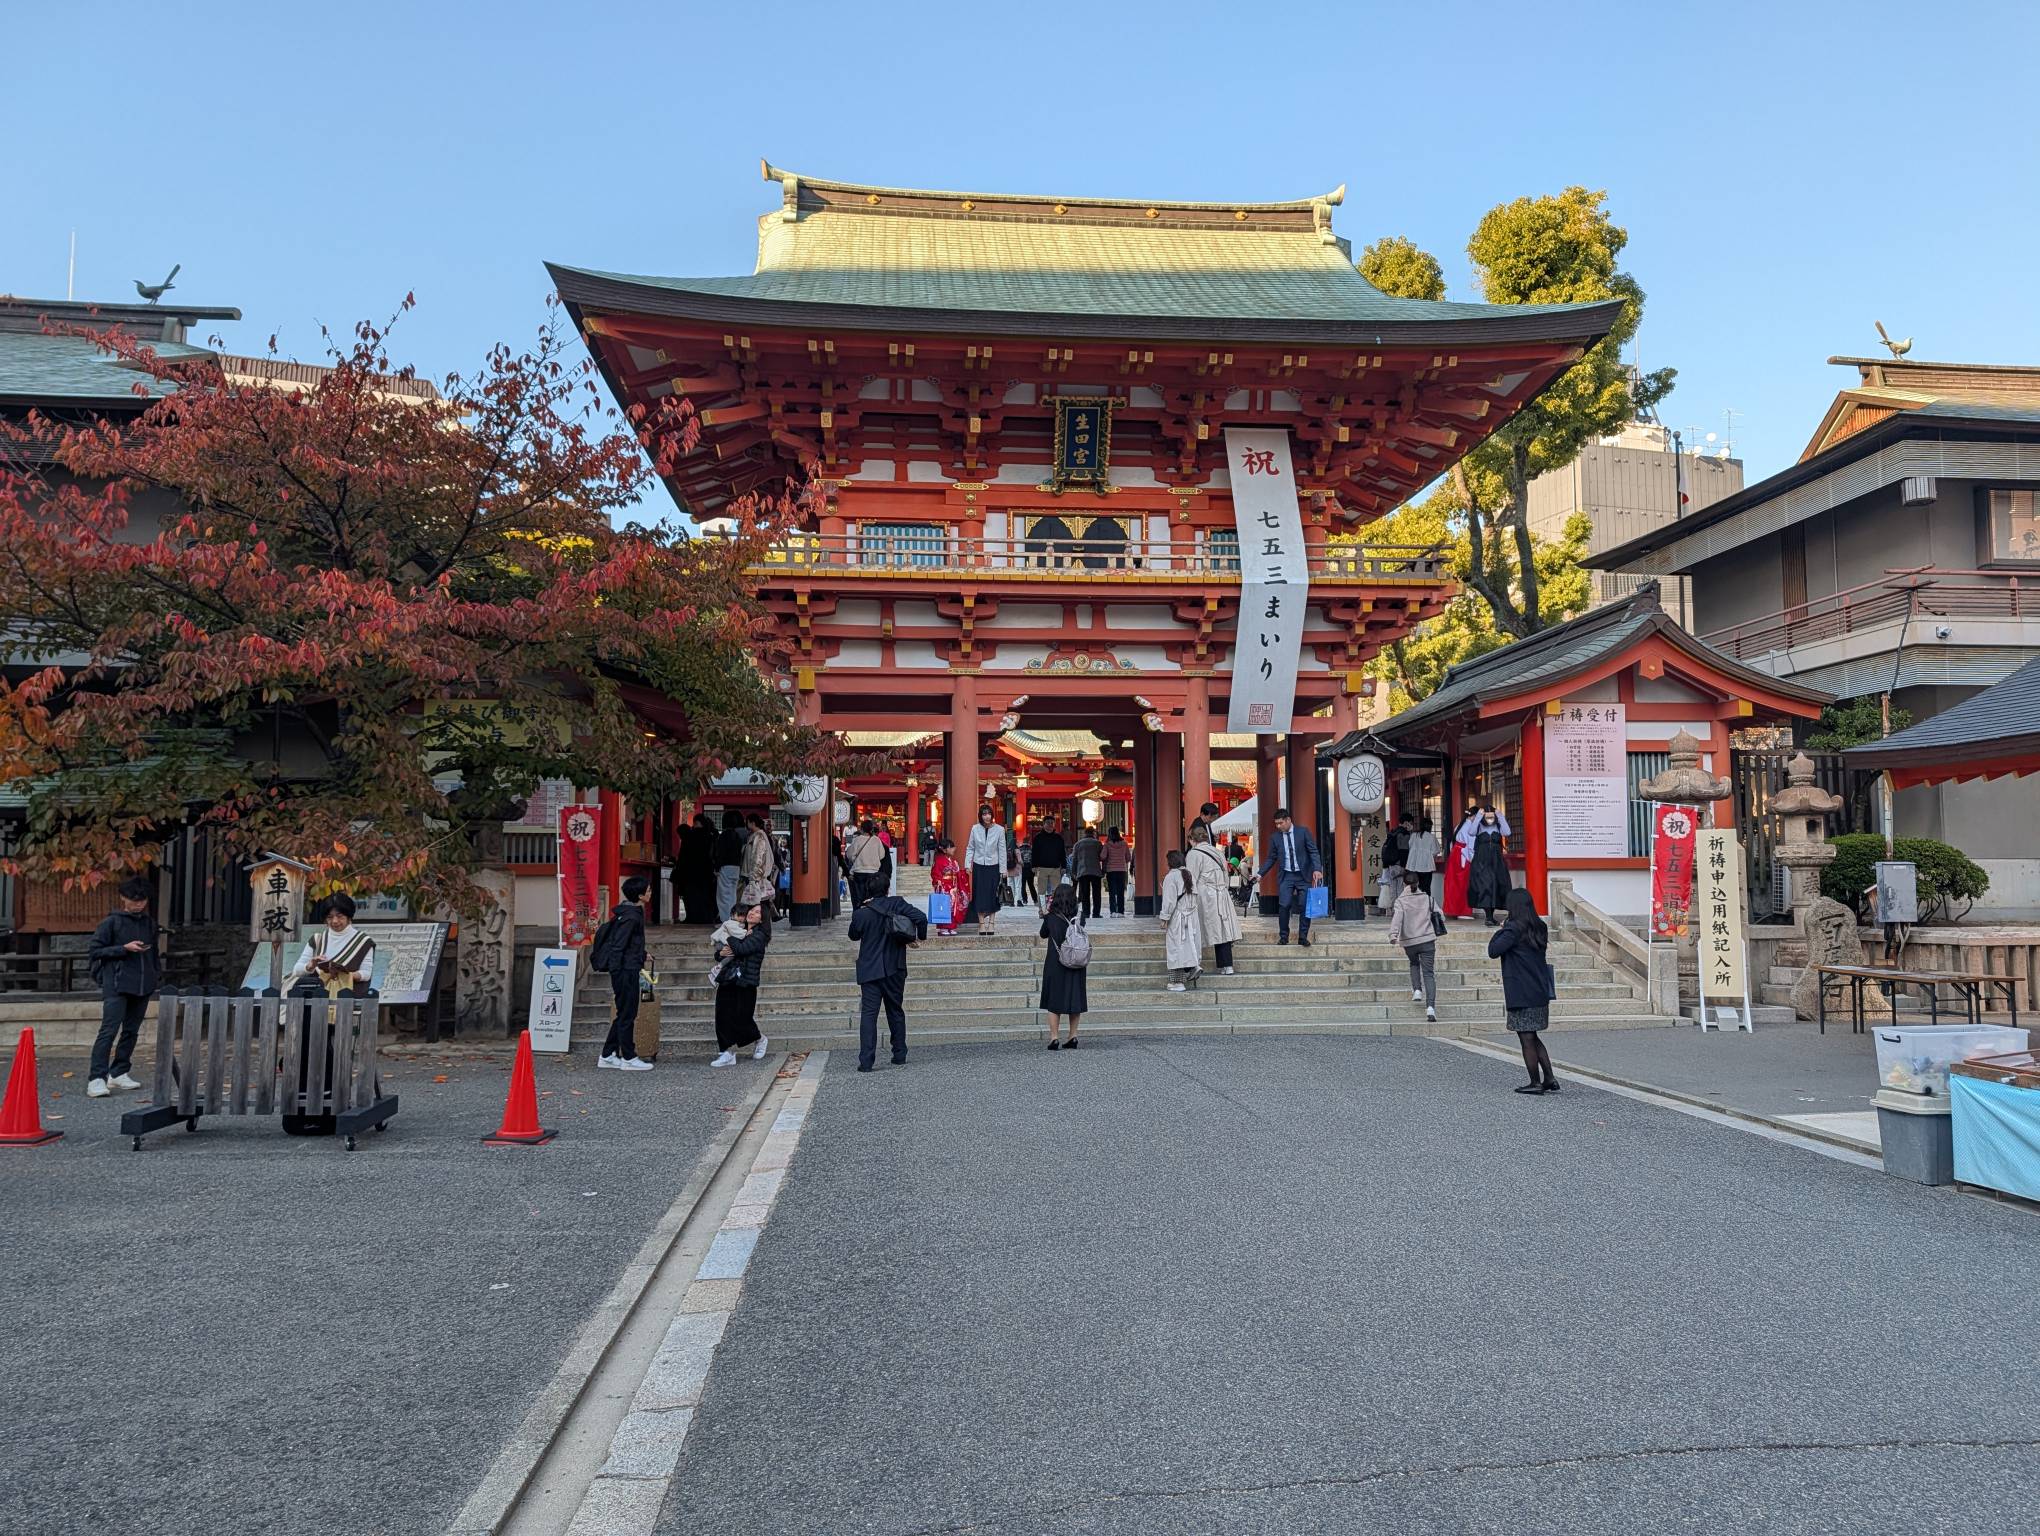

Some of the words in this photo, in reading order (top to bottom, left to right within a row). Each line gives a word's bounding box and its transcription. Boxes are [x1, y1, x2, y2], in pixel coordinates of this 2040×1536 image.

[1073, 413, 1090, 465] 生田宮
[1241, 447, 1280, 476] 祝
[1257, 511, 1288, 681] 七五三まいり
[571, 820, 590, 836] 祝
[1667, 817, 1686, 835] 祝
[262, 868, 294, 934] 車祓
[1708, 835, 1732, 987] 祈祷申込用紙記入所
